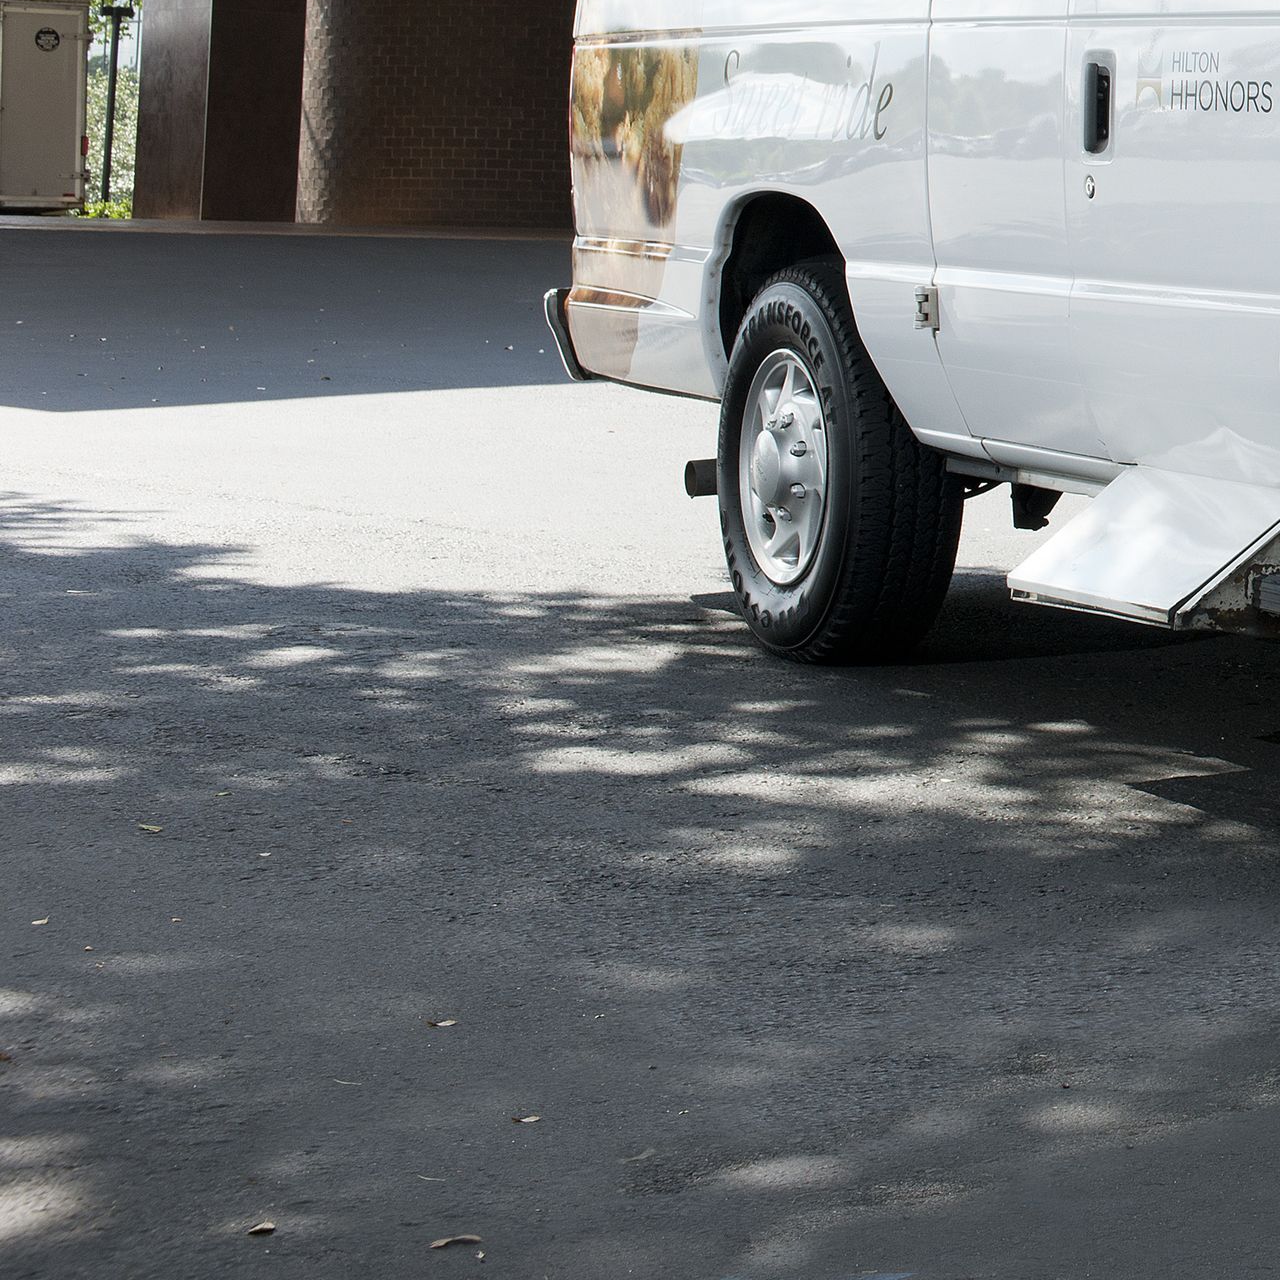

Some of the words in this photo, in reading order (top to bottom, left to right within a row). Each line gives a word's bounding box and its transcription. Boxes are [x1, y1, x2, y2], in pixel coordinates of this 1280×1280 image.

[814, 39, 894, 141] ride
[1170, 79, 1273, 113] HHONORS
[1172, 51, 1220, 73] HILTON
[742, 300, 825, 373] TRANSFORCE
[820, 386, 839, 425] AT
